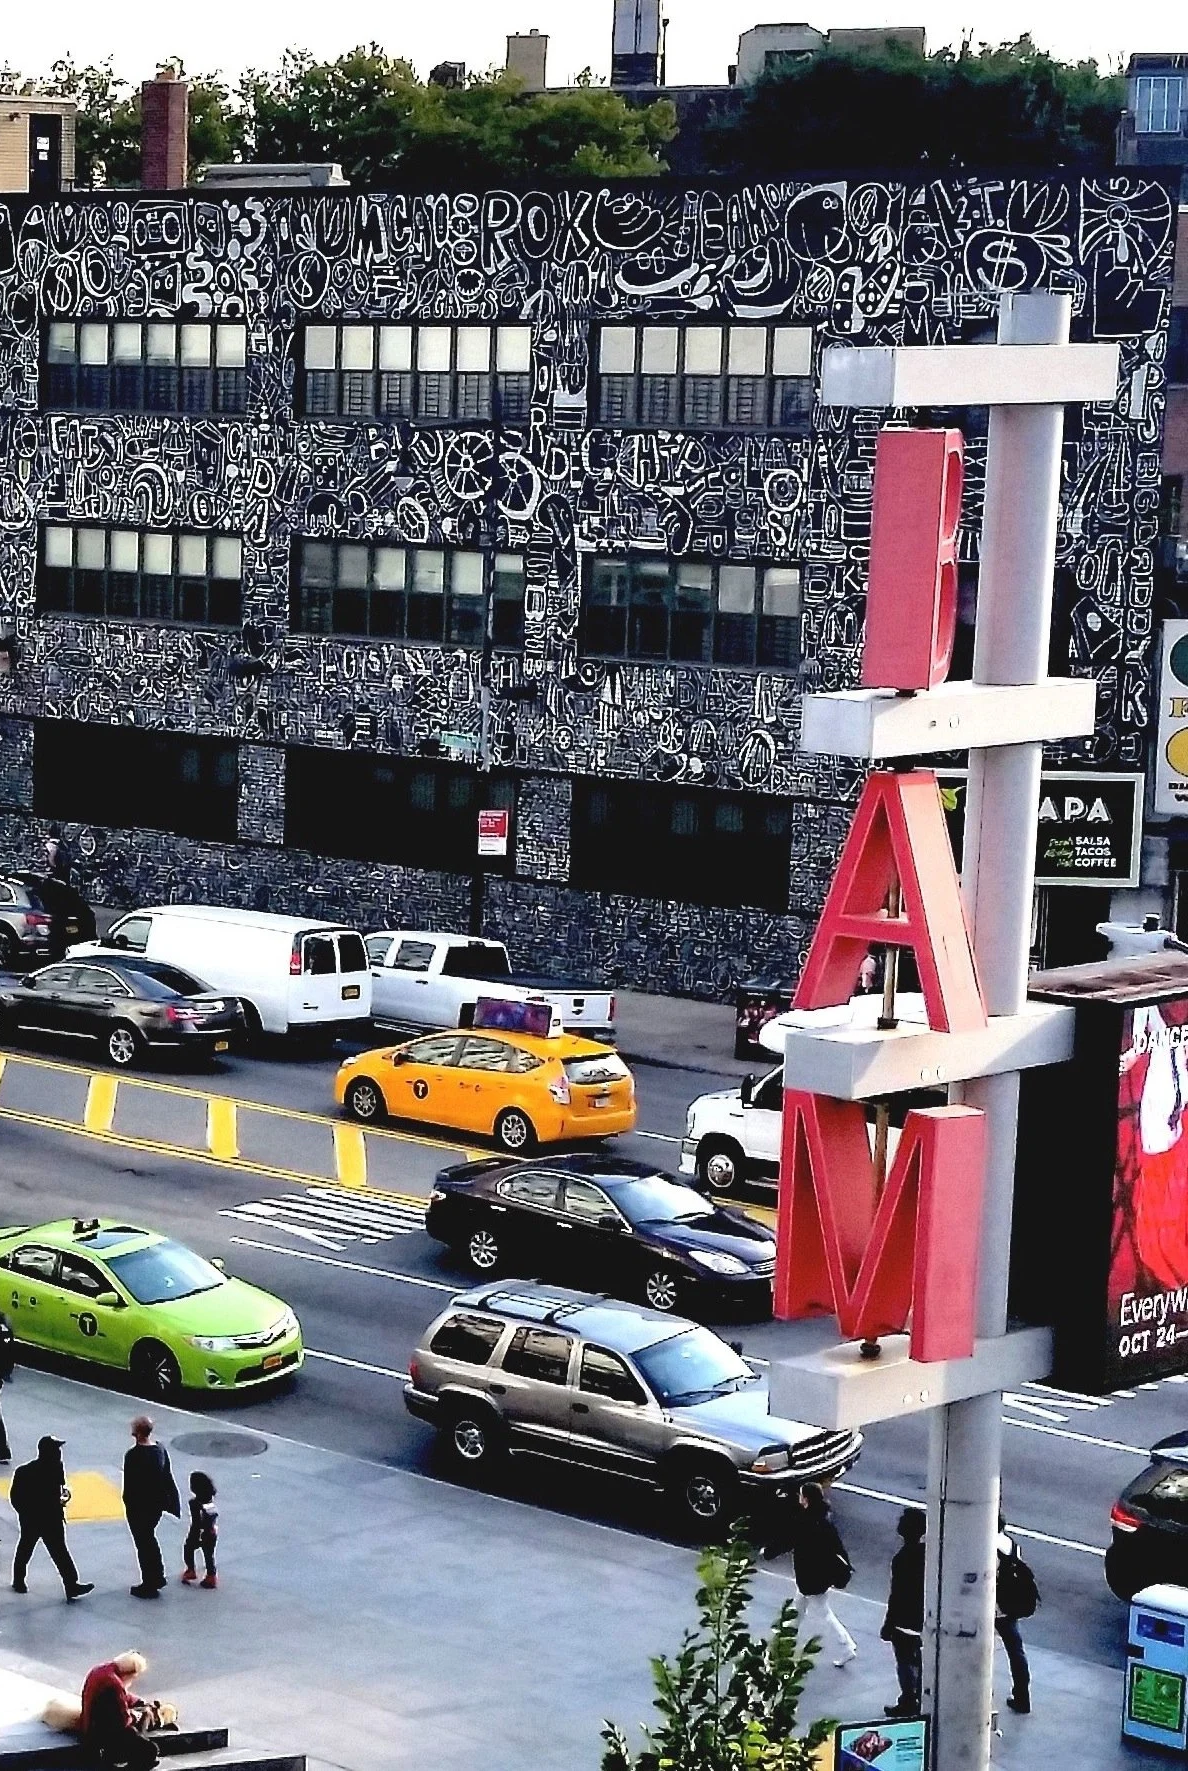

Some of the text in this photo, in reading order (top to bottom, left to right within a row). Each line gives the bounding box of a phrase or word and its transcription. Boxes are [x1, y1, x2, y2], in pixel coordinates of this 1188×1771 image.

[1075, 836, 1111, 846] SALSA
[1075, 847, 1112, 856] TACOS
[1074, 858, 1117, 868] COFFEE
[1120, 1286, 1188, 1327] Everyw
[1118, 1329, 1151, 1358] OCT
